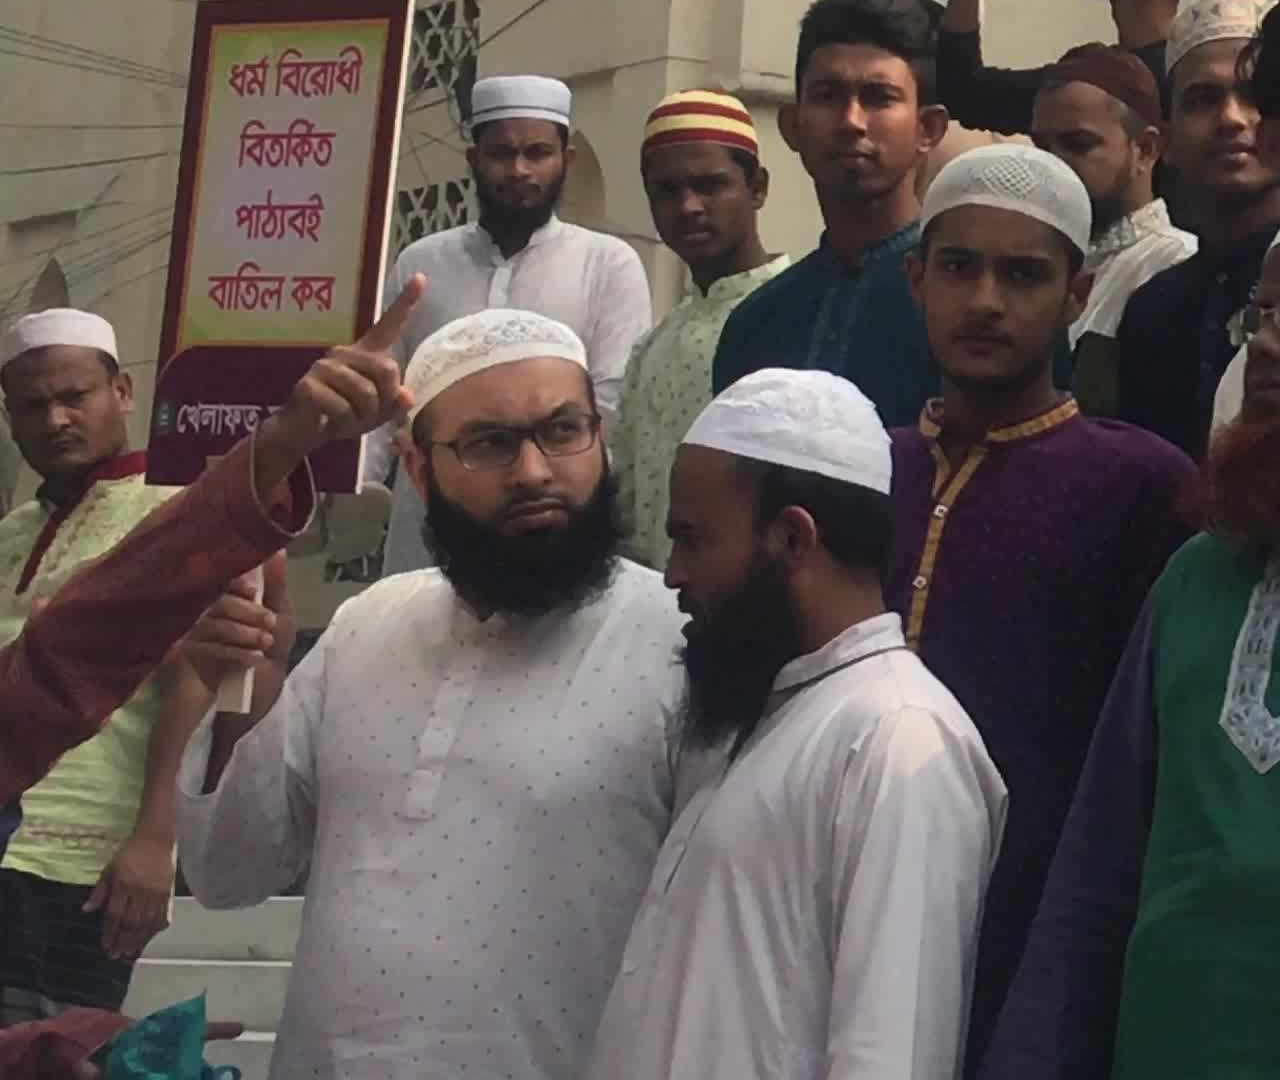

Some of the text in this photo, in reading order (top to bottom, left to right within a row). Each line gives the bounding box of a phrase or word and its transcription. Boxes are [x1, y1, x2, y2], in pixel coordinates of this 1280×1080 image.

[229, 46, 363, 98] ধর্ম বিরোধী
[238, 119, 335, 168] বিতর্কিত
[236, 190, 323, 242] পাঠ্যবই
[208, 262, 335, 312] বাতিল কর
[177, 403, 261, 434] খেলাফত
